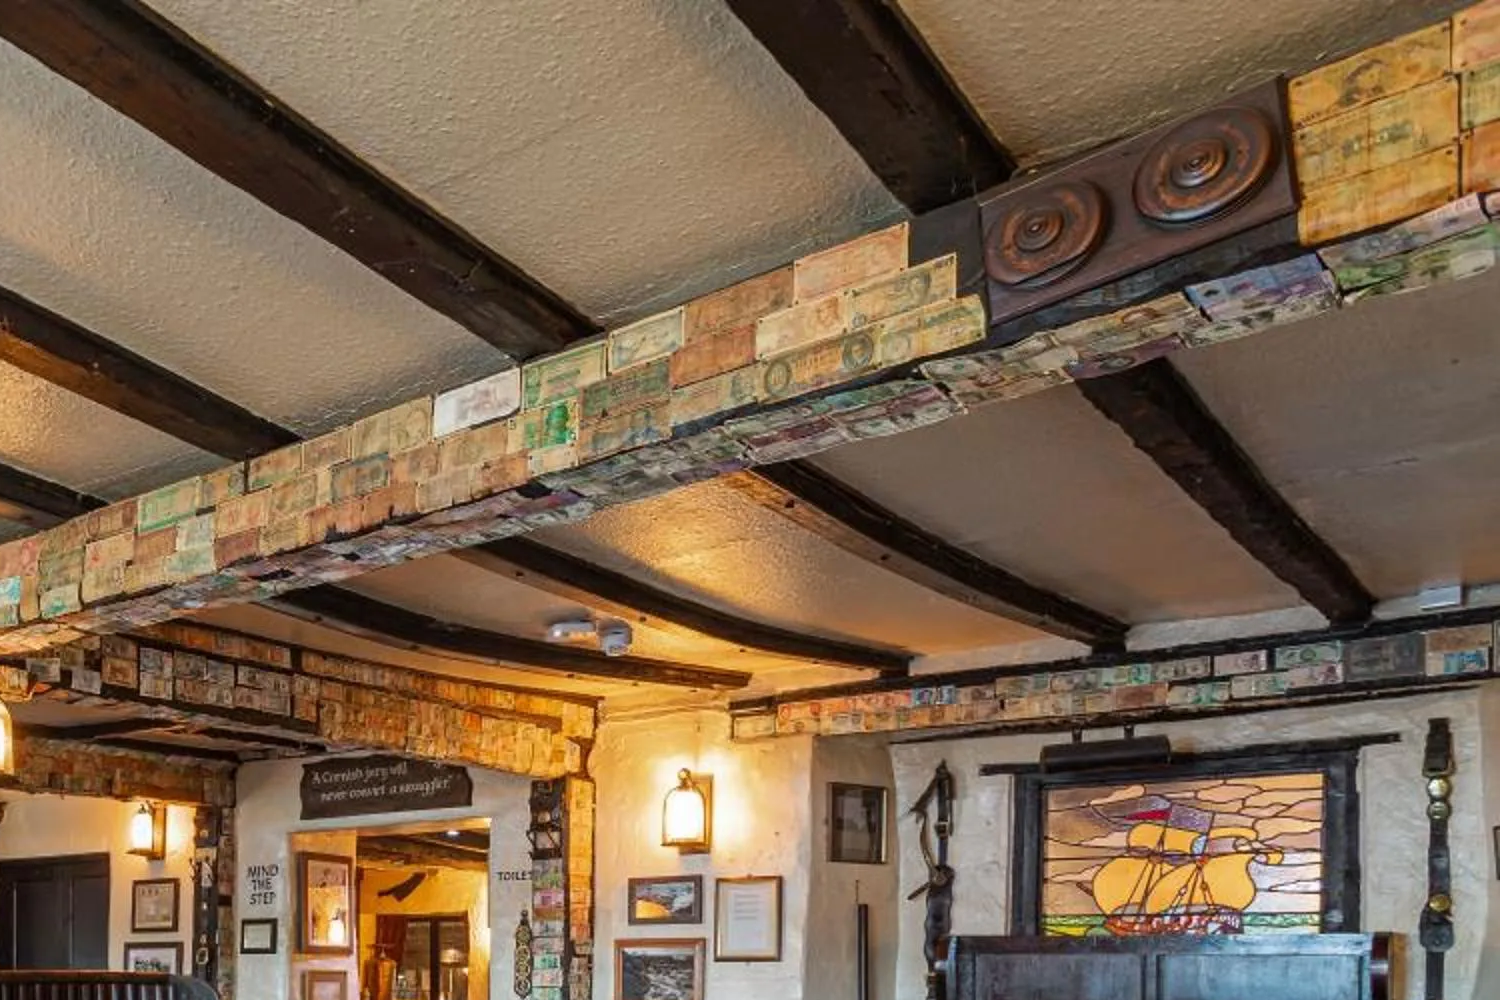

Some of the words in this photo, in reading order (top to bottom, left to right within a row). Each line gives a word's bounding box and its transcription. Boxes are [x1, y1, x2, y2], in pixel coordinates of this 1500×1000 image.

[321, 767, 363, 783] Cornish
[321, 791, 348, 802] never
[389, 786, 398, 795] a
[247, 864, 279, 878] MIND
[251, 878, 273, 891] THE
[249, 891, 277, 905] STEP
